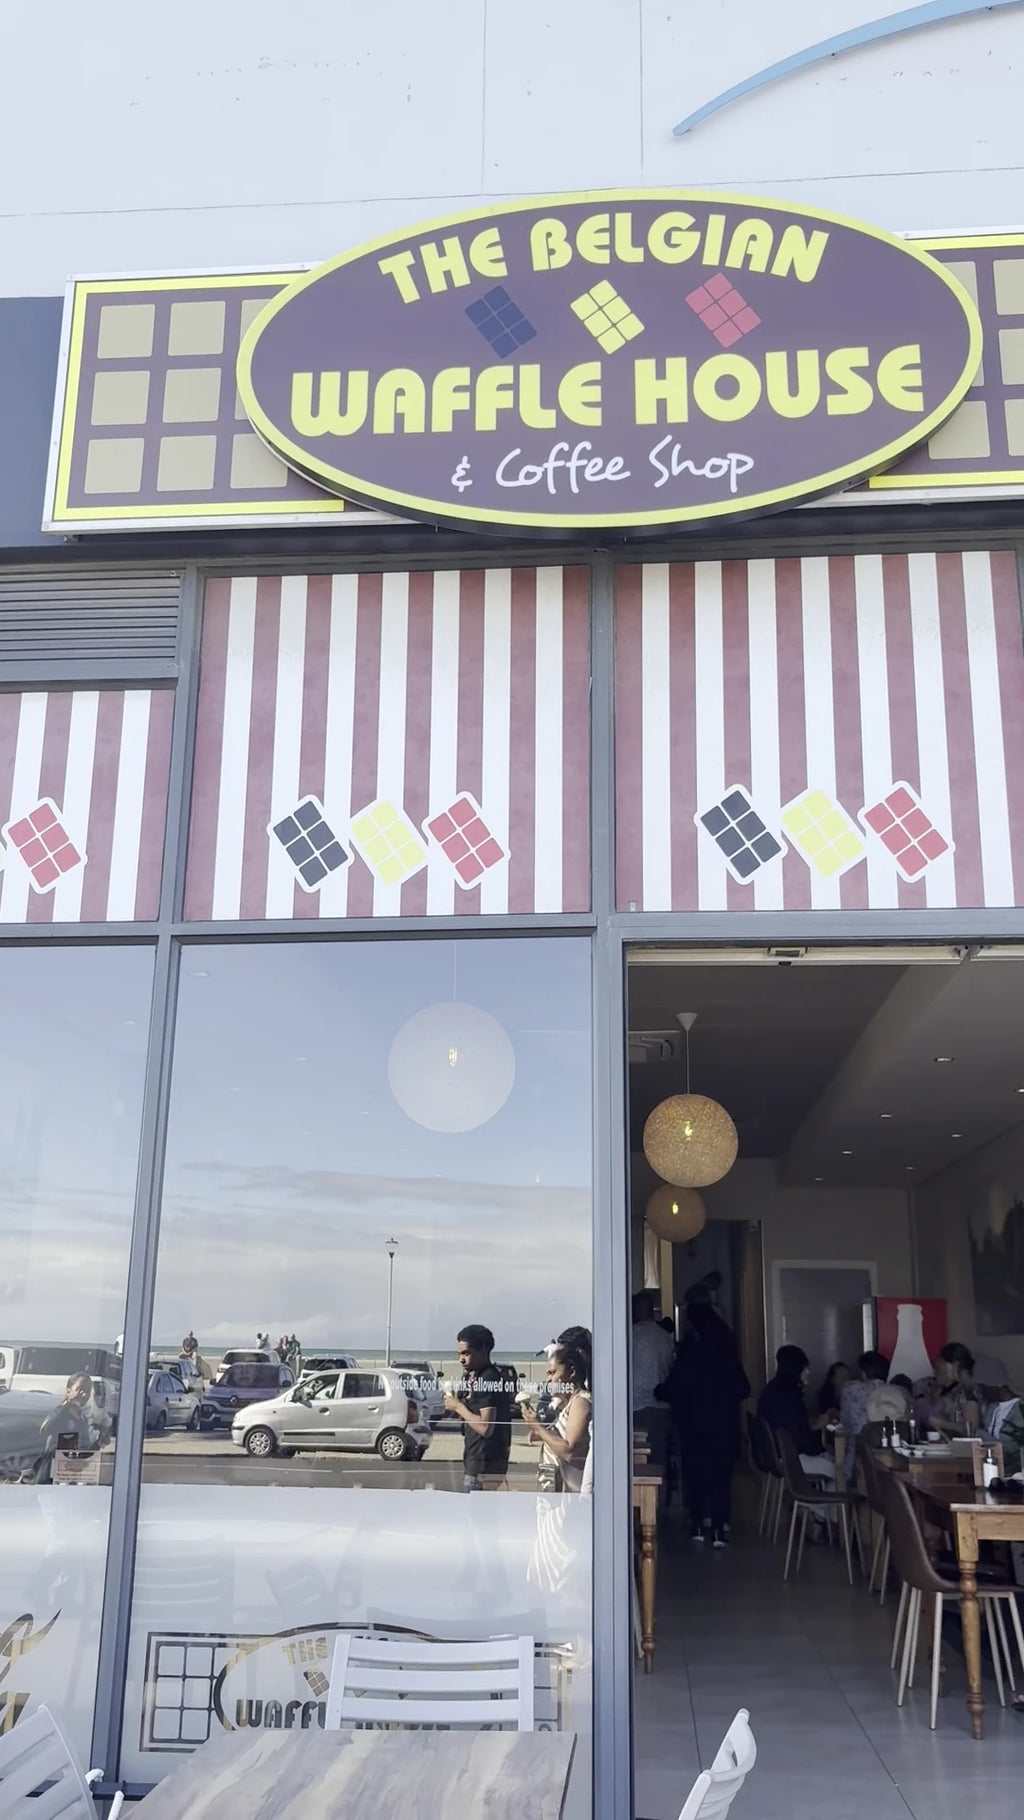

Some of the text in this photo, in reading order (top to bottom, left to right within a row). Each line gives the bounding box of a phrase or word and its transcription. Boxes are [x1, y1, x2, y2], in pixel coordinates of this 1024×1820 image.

[378, 211, 829, 304] THE BELGIAN
[290, 344, 925, 437] WAFFLE HOUSE
[450, 434, 755, 494] & Coffee Shop
[419, 1376, 437, 1391] food
[473, 1377, 503, 1392] allowed
[504, 1381, 515, 1393] on
[281, 1637, 327, 1665] THE
